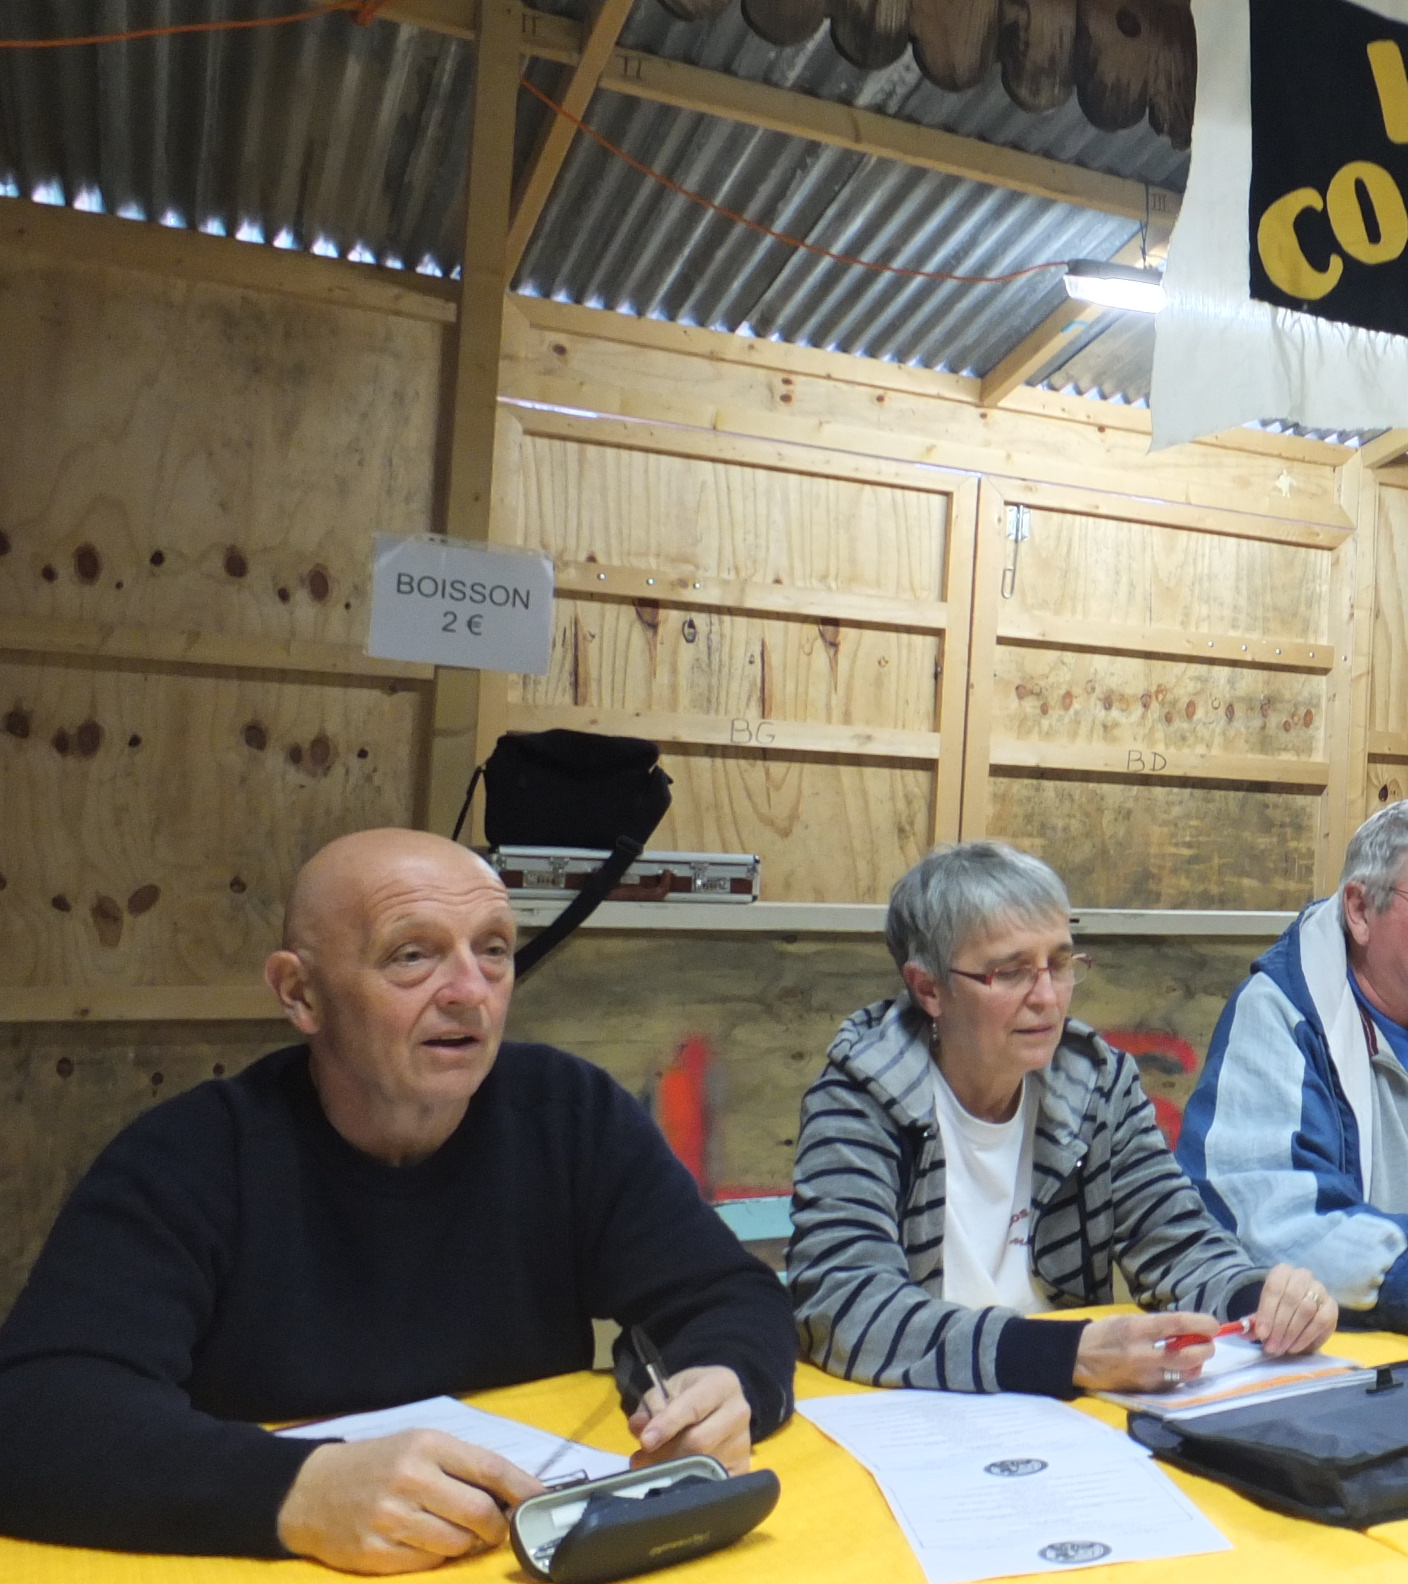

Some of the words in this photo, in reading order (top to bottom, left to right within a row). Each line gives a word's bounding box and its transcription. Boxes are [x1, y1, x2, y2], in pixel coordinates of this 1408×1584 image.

[396, 572, 531, 610] BOISSON
[441, 610, 458, 633] 2
[466, 613, 484, 636] €
[729, 717, 776, 745] BG
[1126, 749, 1167, 772] BD
